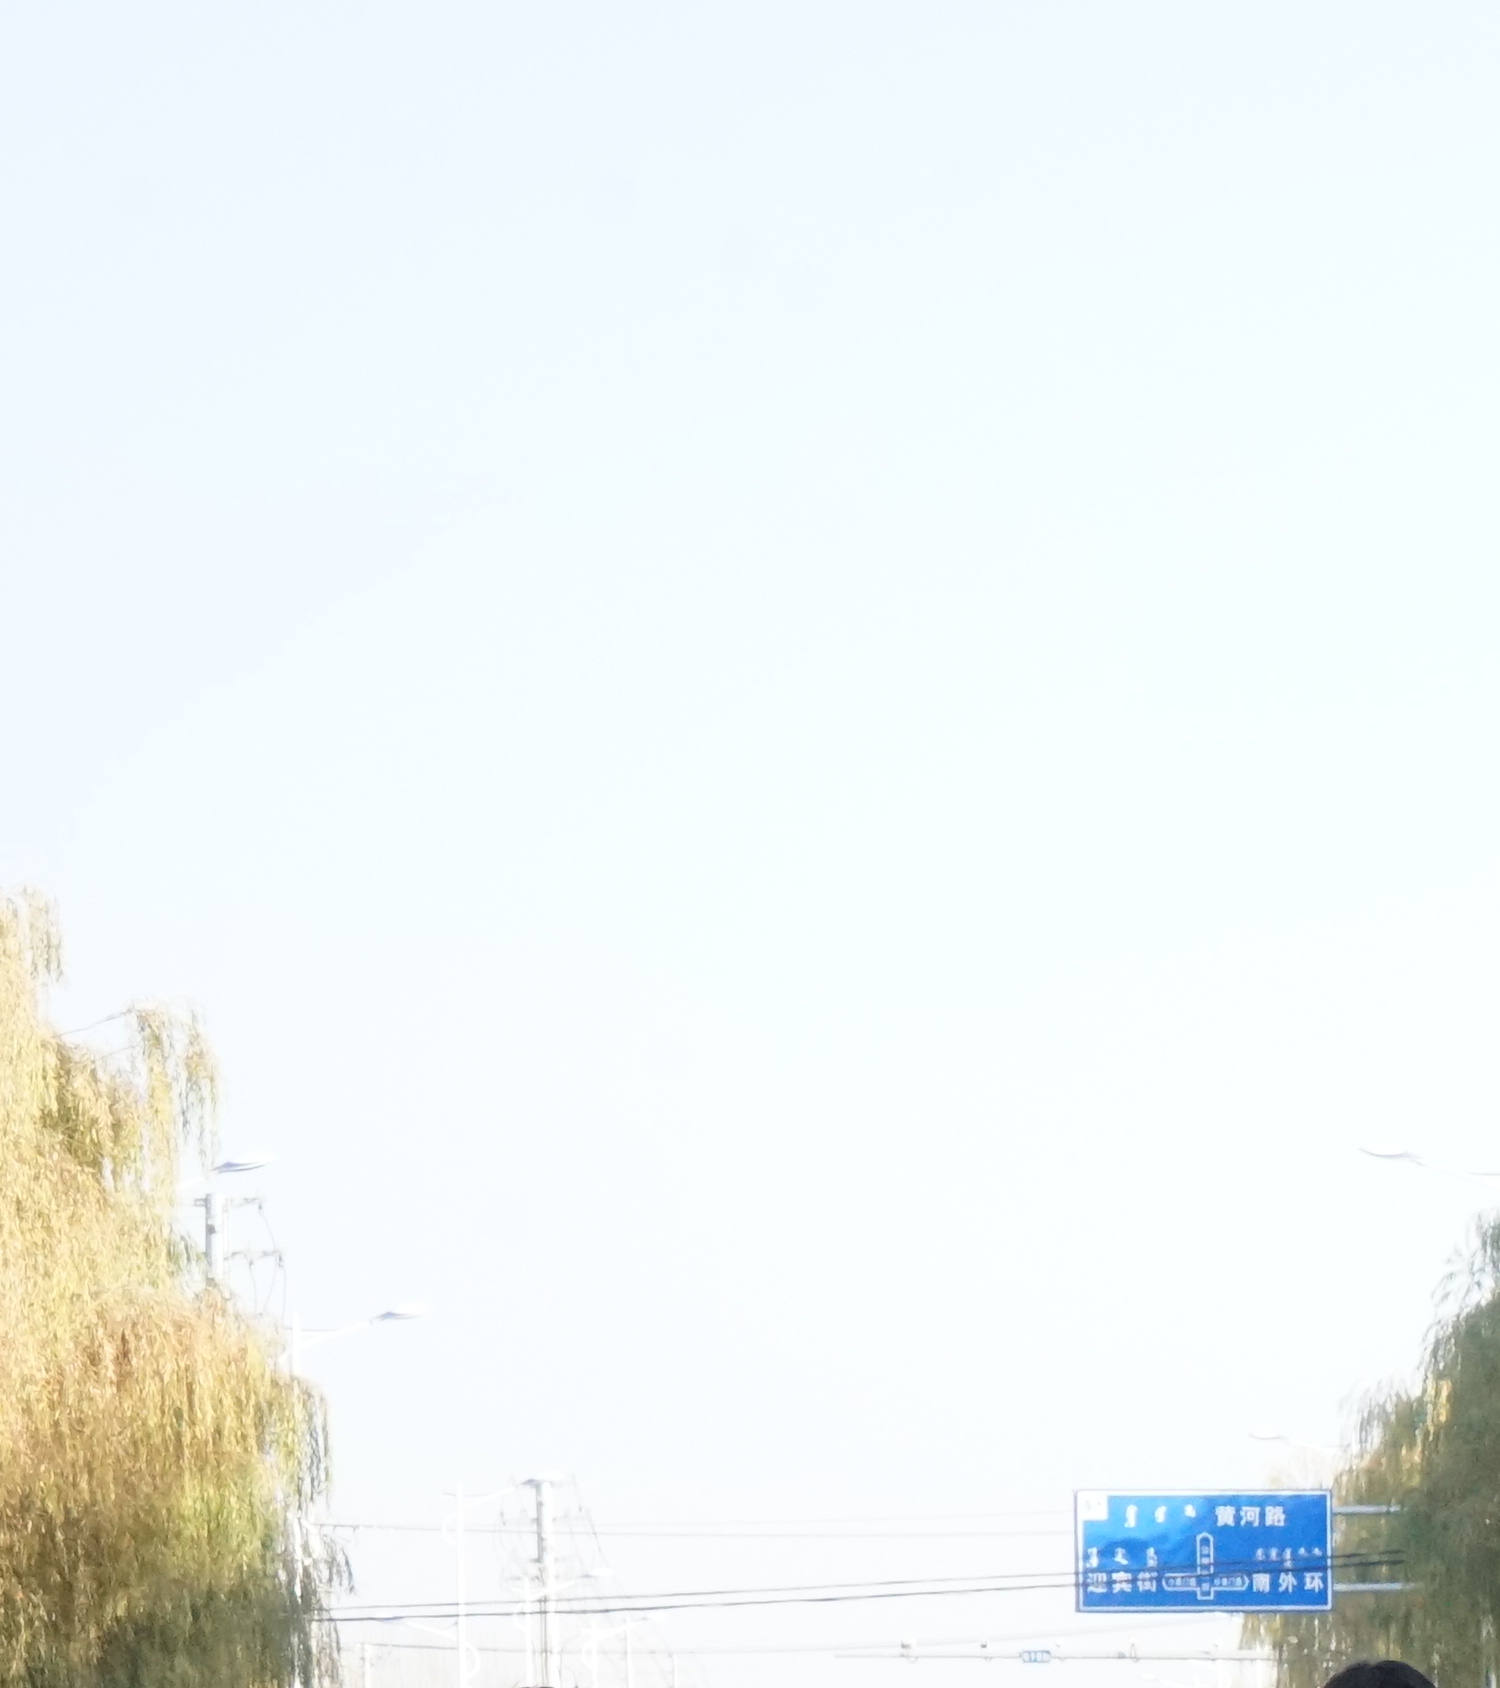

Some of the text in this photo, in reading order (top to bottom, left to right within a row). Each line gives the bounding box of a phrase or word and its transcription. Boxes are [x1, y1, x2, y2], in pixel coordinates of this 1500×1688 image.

[1214, 1504, 1287, 1527] 黄河路
[1251, 1571, 1325, 1593] 南外环
